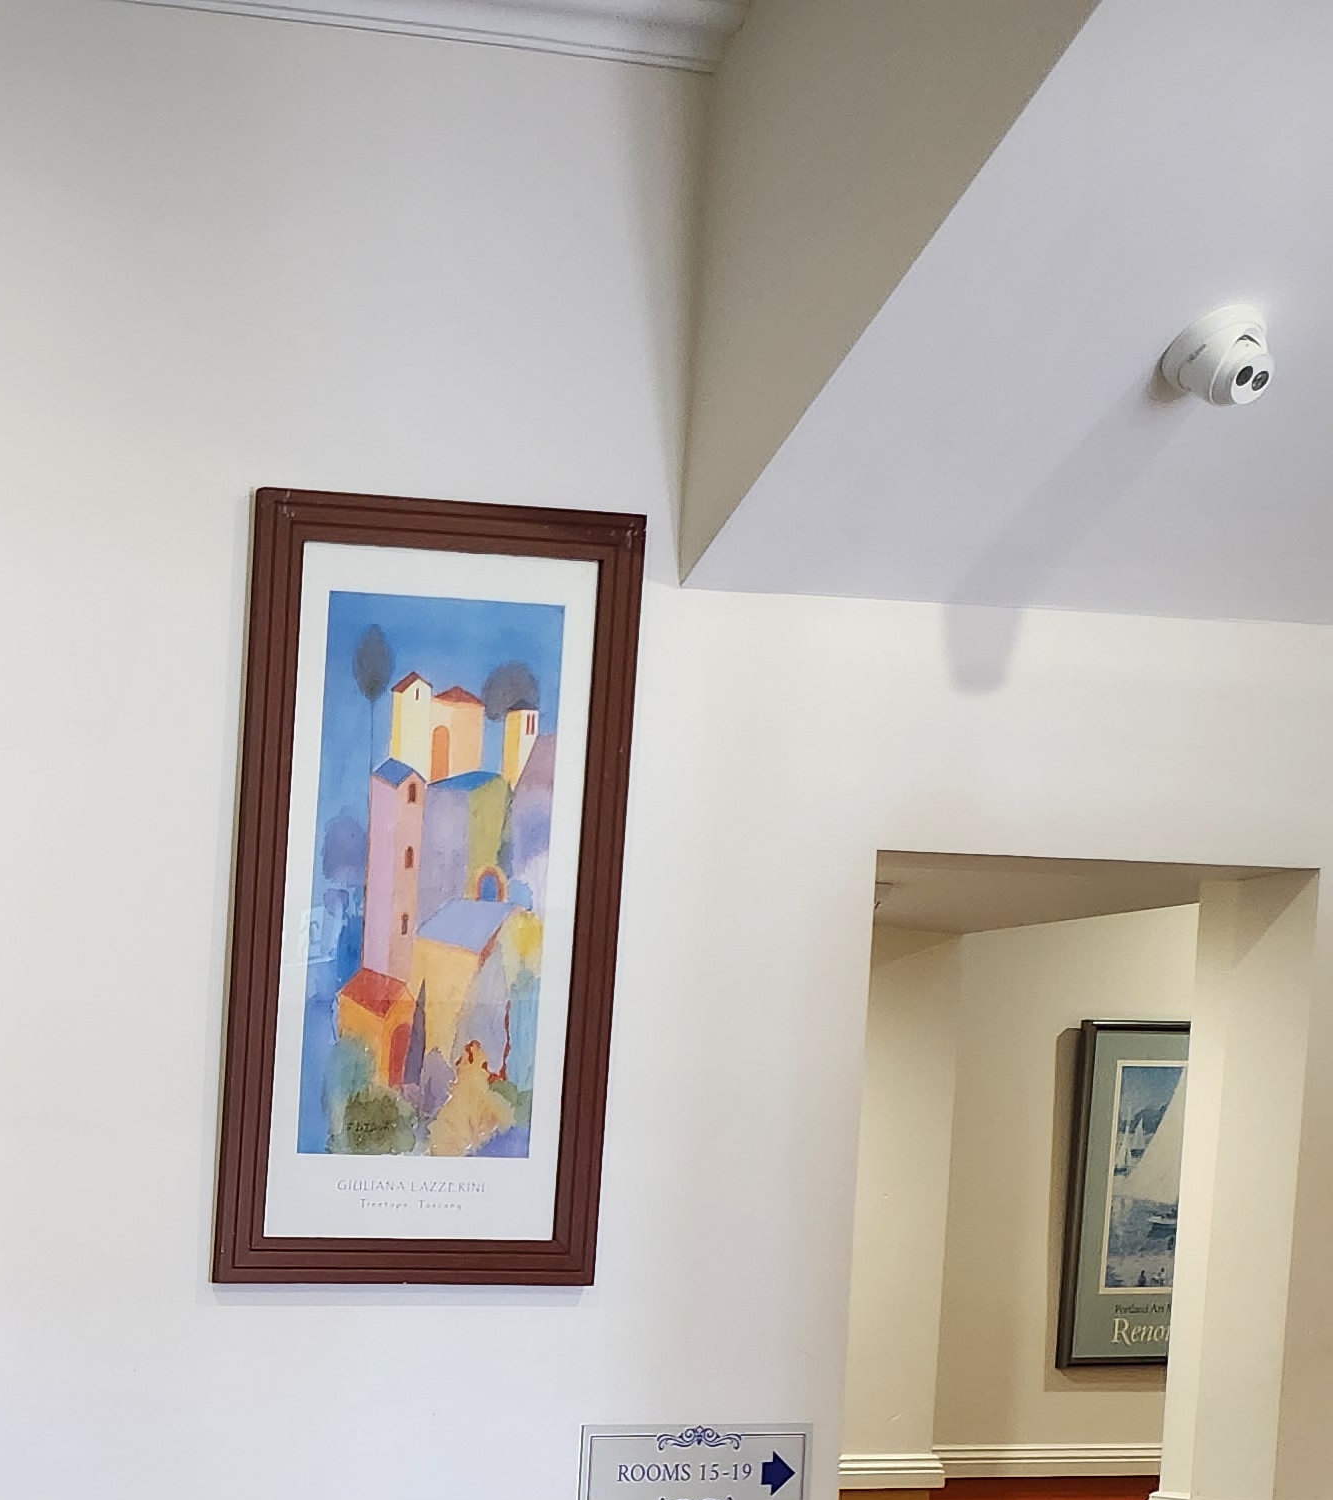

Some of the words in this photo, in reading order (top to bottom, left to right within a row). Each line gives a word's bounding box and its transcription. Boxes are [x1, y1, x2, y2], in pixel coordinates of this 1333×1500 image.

[337, 1179, 405, 1192] GIULIANA
[410, 1181, 486, 1193] LAZZERINI
[616, 1463, 692, 1482] ROOMS
[699, 1463, 753, 1482] 15-19
